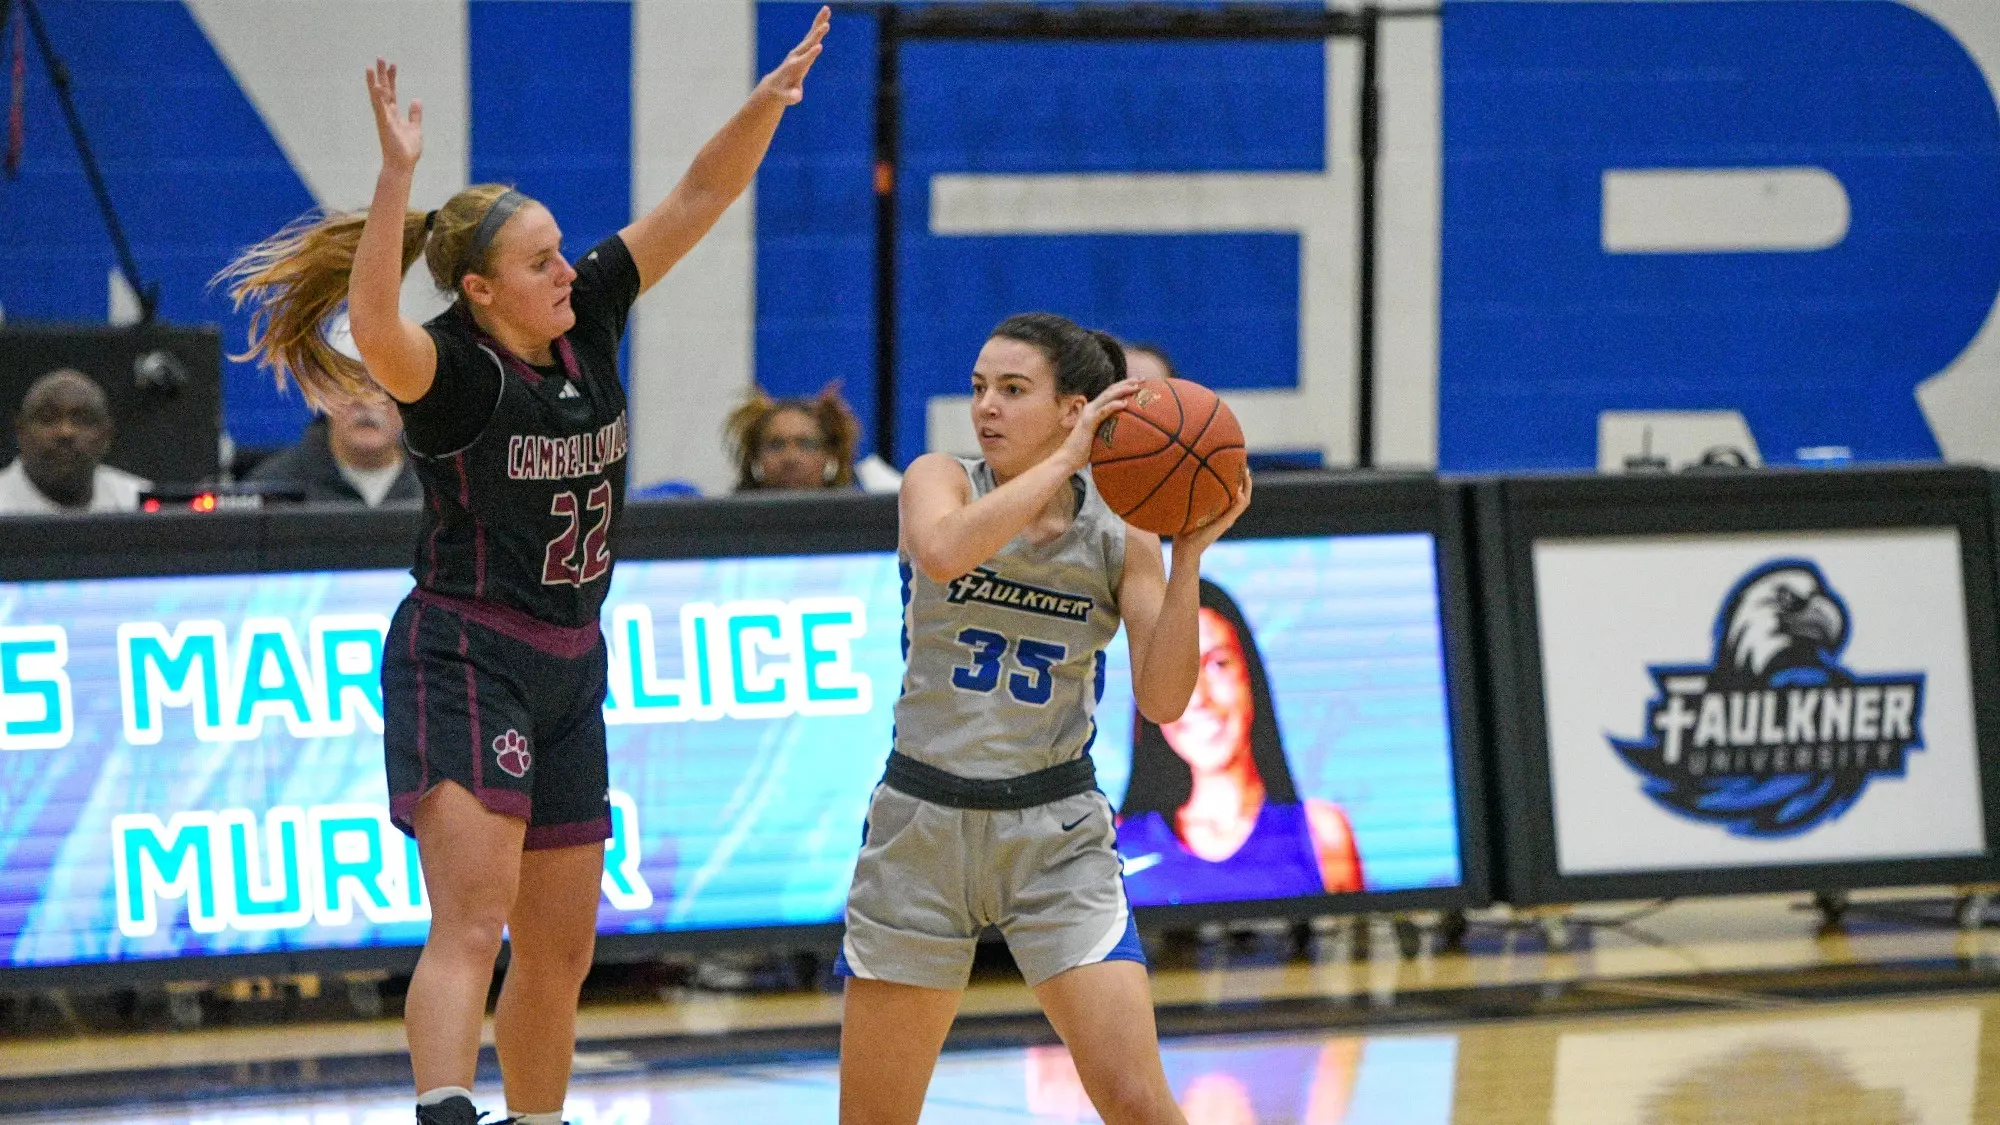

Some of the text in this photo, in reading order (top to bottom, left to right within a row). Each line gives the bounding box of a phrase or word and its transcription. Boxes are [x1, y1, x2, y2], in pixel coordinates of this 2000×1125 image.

[540, 480, 612, 588] 22
[952, 569, 1092, 618] FAULKNER
[118, 614, 387, 745] MAR
[602, 602, 870, 723] LICE
[951, 627, 1068, 708] 35
[1652, 676, 1915, 764] FAULKNER
